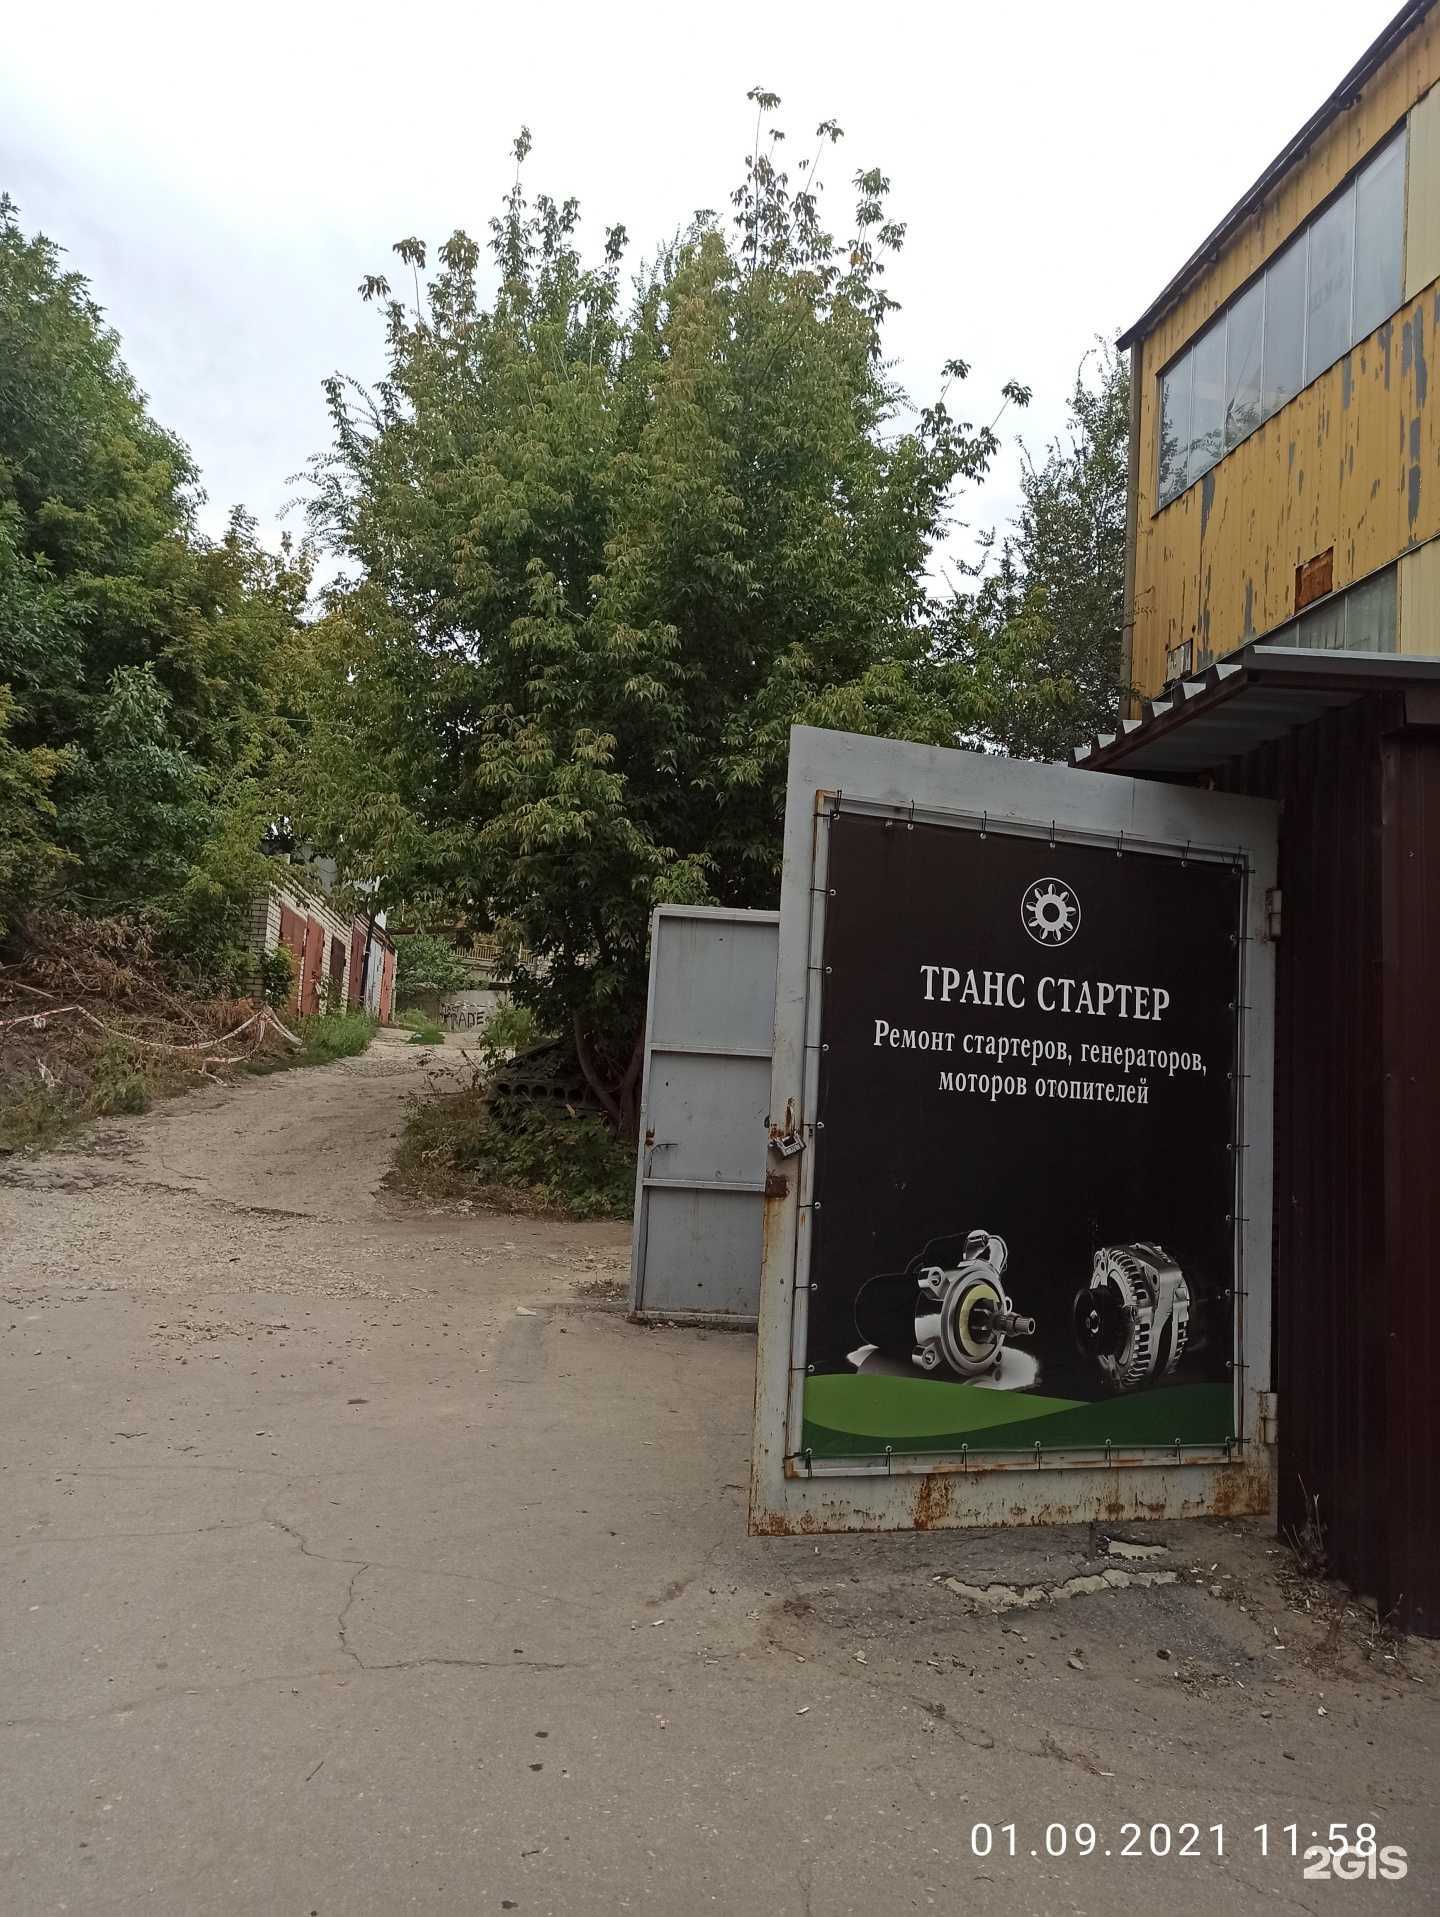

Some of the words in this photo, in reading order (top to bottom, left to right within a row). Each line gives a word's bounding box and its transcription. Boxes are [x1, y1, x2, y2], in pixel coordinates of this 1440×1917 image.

[919, 965, 1026, 1009] ТРАНС
[1037, 976, 1170, 1021] СТАРТЕР
[873, 1019, 956, 1052] Ремонт
[962, 1034, 1073, 1066] стартеров,
[1080, 1043, 1207, 1077] генераторов,
[938, 1071, 1027, 1102] моторов
[1034, 1077, 1149, 1104] отопителей
